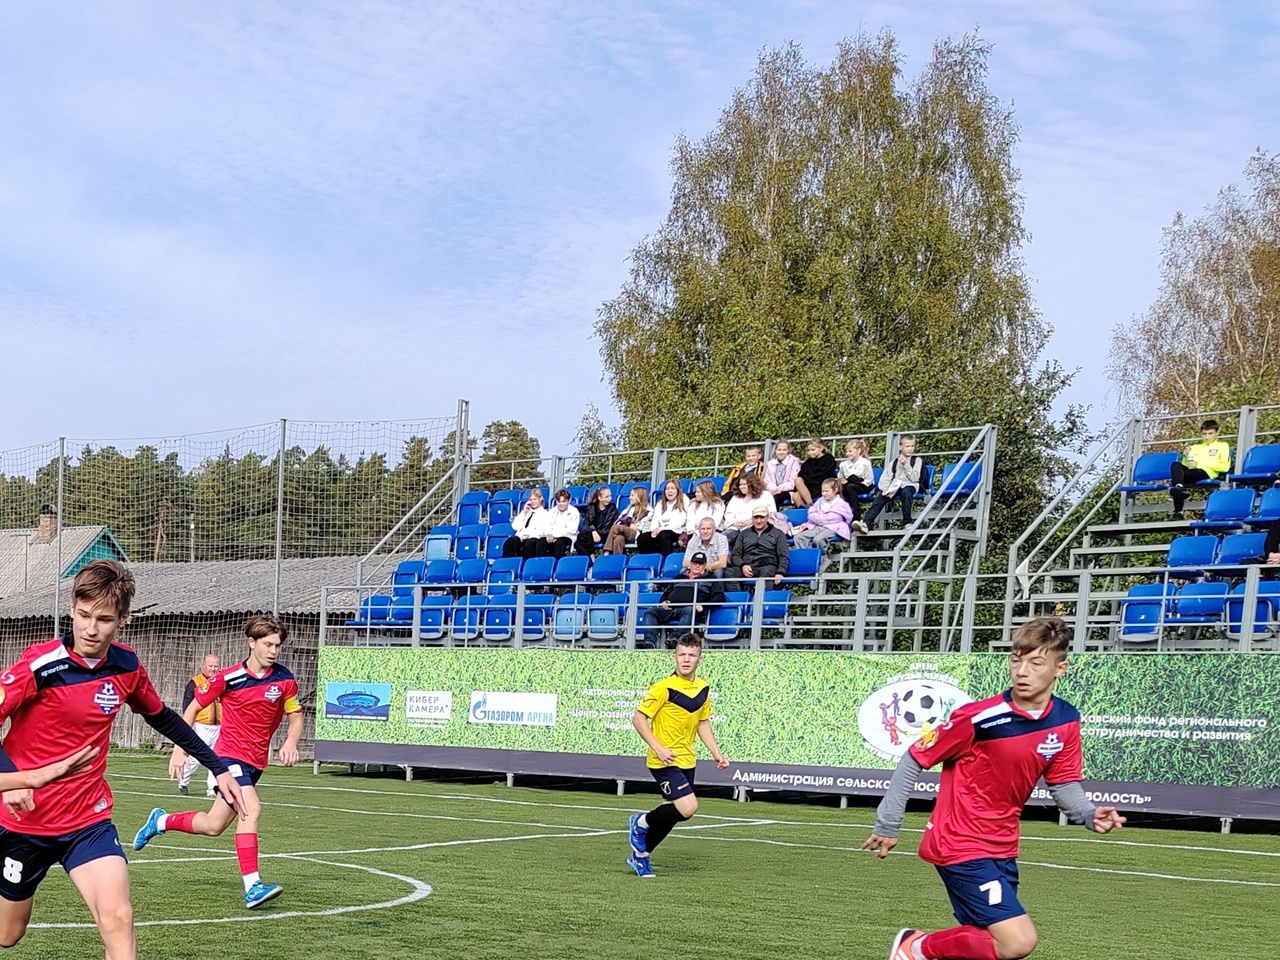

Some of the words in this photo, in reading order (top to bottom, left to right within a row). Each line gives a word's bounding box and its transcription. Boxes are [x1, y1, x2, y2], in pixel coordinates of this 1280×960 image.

[409, 695, 439, 704] КИБЕР
[409, 705, 446, 714] КАМЕРА
[600, 711, 635, 720] развити
[487, 710, 524, 722] ГАЗПРОМ
[527, 711, 554, 723] АРЕНА
[1080, 713, 1131, 725] ковский
[1134, 714, 1166, 727] фонд
[1170, 716, 1267, 728] регионального
[1080, 728, 1178, 740] сотрудничества
[1181, 731, 1190, 739] и
[1193, 731, 1252, 741] развития
[732, 769, 833, 787] Администрация
[837, 777, 890, 790] сельско
[3, 856, 23, 884] 8
